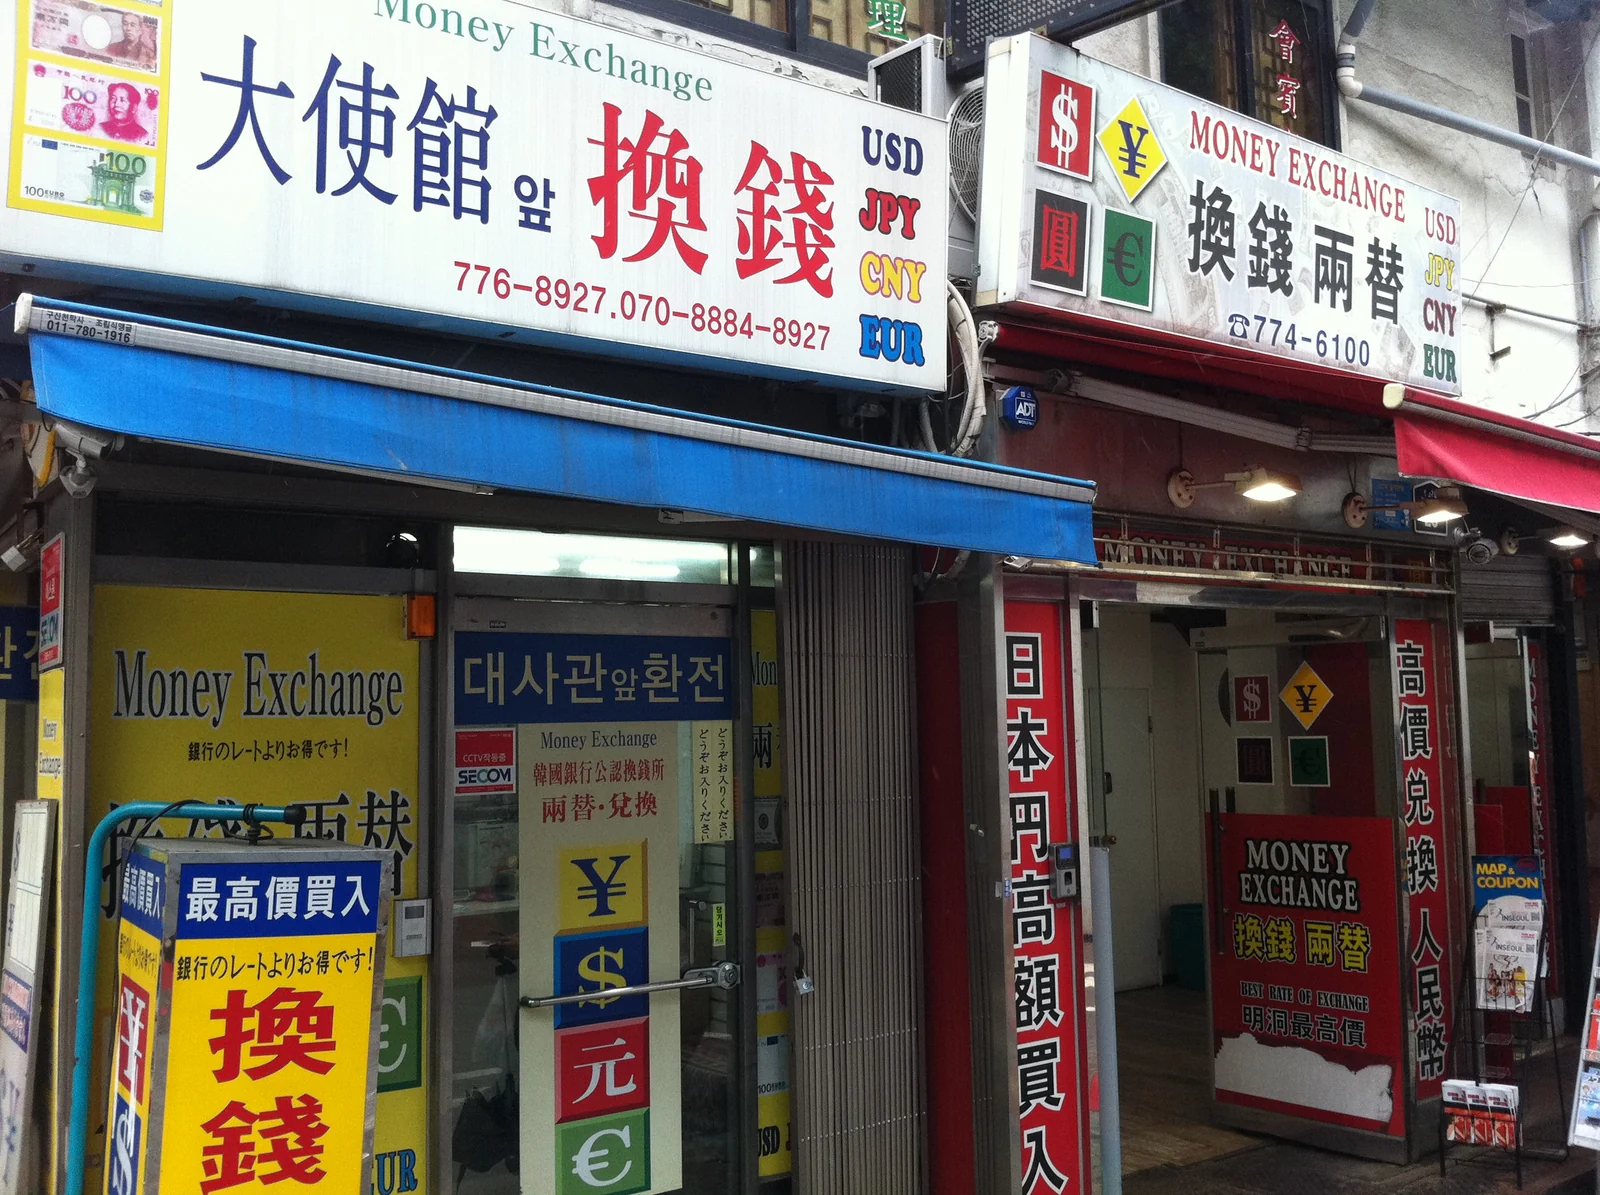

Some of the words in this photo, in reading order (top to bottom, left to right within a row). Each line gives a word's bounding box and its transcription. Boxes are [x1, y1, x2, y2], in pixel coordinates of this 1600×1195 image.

[374, 0, 514, 52] Money
[529, 22, 713, 101] Exchange
[1268, 18, 1301, 134] 會賓
[62, 85, 97, 105] 100
[862, 125, 924, 176] USD
[1051, 83, 1079, 168] $
[1118, 119, 1149, 178] ¥
[106, 151, 147, 175] 100
[1189, 111, 1280, 177] MONEY
[1288, 147, 1406, 222] EXCHANGE
[24, 185, 44, 197] 100
[587, 101, 836, 298] 換錢
[859, 187, 920, 240] JPY
[1041, 203, 1079, 277] 圓
[1188, 179, 1294, 297] 換錢
[1314, 224, 1404, 325] 兩替
[1425, 207, 1457, 246] USD
[860, 251, 927, 303] CNY
[1107, 231, 1144, 287] €
[1425, 252, 1456, 291] JPY
[47, 320, 131, 343] 011-780-1916
[454, 261, 831, 351] 776-8927.070-8884-8927
[1423, 297, 1457, 337] CNY
[859, 313, 926, 367] EUR
[1254, 314, 1370, 367] 774-6100
[1423, 343, 1457, 383] EUR
[1016, 402, 1036, 418] ADT
[1101, 533, 1207, 569] MONEY
[113, 650, 232, 728] Money
[243, 650, 403, 726] Exchange
[1243, 679, 1261, 719] $
[1294, 685, 1317, 713] ¥
[541, 731, 587, 750] Money
[592, 730, 657, 748] Exchange
[459, 767, 511, 785] SECOM
[1246, 840, 1349, 875] MONEY
[1476, 863, 1507, 875] MAP
[1508, 867, 1515, 875] &
[1477, 876, 1539, 889] COUPON
[185, 875, 371, 922] 最高價買入
[570, 855, 631, 918] ¥
[1240, 873, 1358, 911] EXCHANGE
[1004, 632, 1068, 1195] 日本円高額買入
[1234, 913, 1296, 962] 換錢
[1304, 919, 1371, 973] 兩替
[577, 946, 627, 1009] $
[1241, 981, 1264, 999] BEST
[1269, 984, 1293, 1002] RATE
[1299, 988, 1312, 1005] OF
[1317, 990, 1369, 1013] EXCHANGE
[1242, 1004, 1367, 1049] 明洞最高價
[199, 986, 337, 1195] 換錢
[573, 1038, 637, 1105] 元
[370, 1148, 419, 1195] UR
[571, 1125, 632, 1187] €
